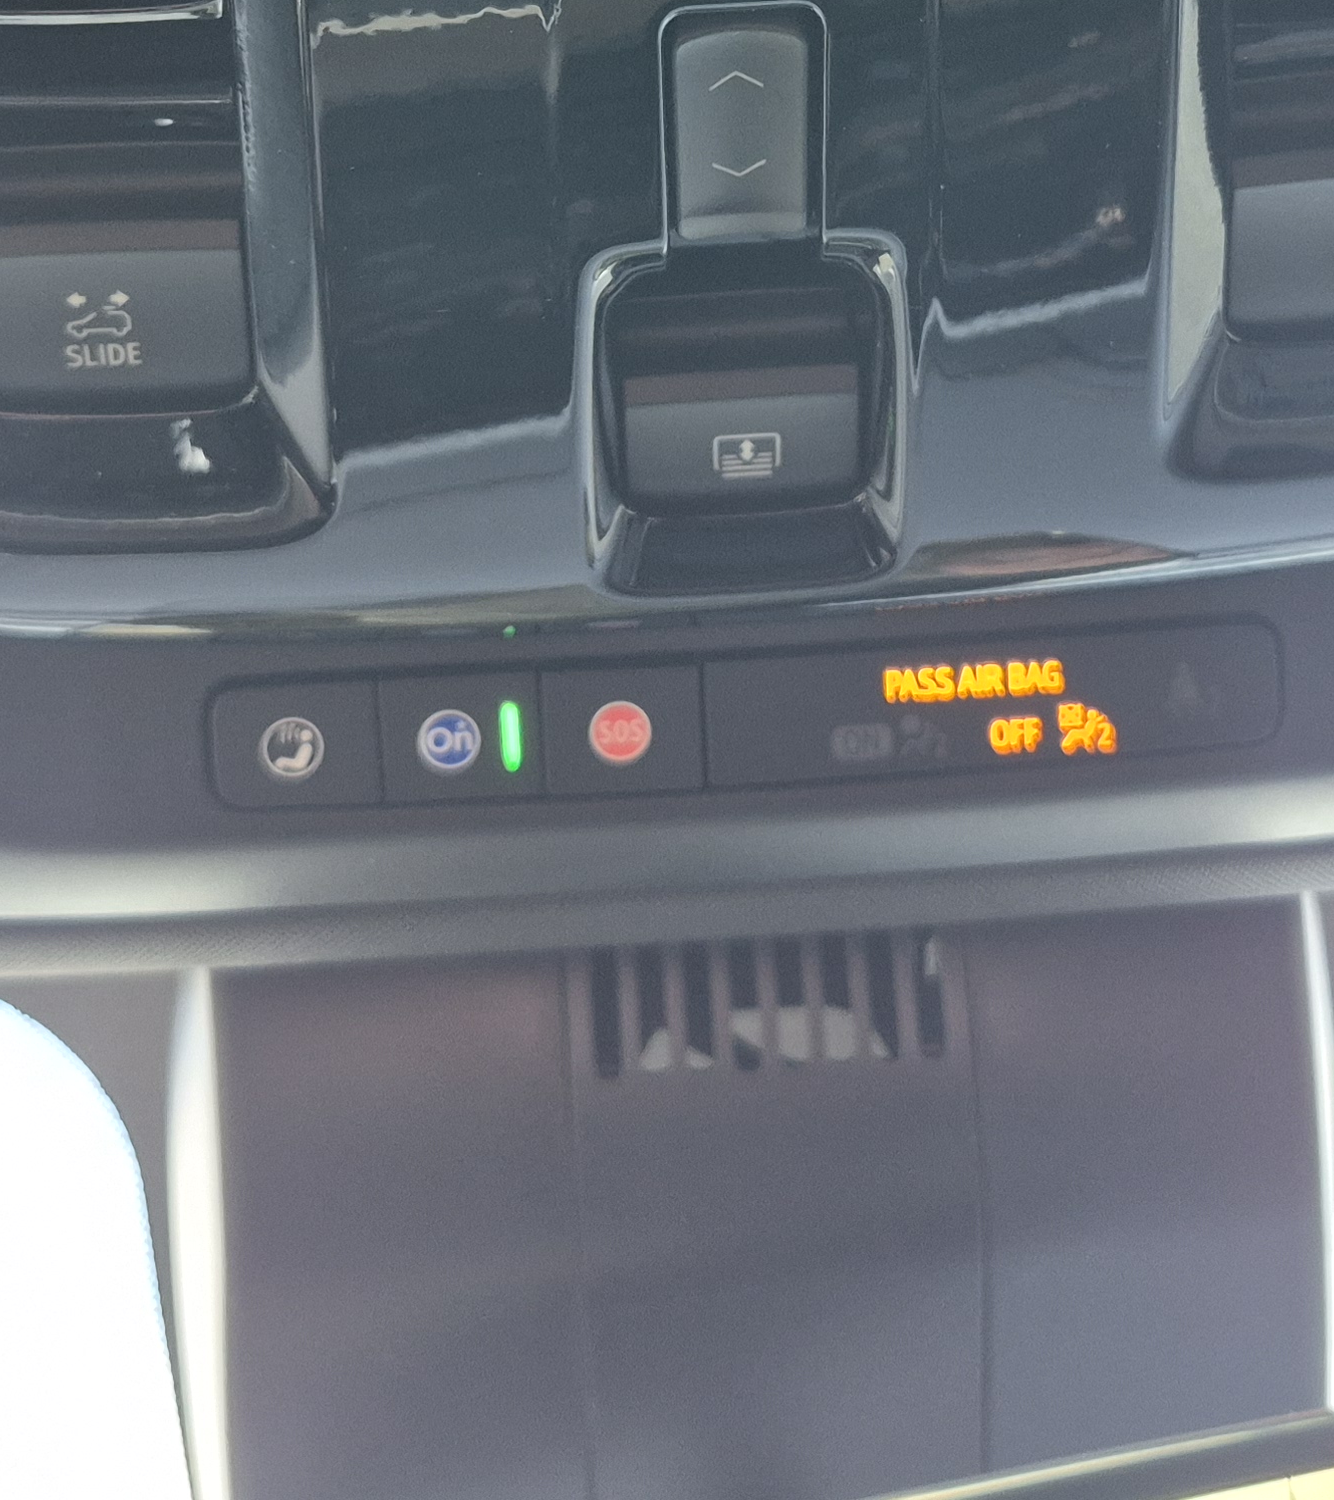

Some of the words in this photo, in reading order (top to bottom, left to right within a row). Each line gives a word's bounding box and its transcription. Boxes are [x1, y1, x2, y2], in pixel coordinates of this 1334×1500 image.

[66, 342, 142, 368] SLIDE
[883, 666, 955, 703] PASS
[957, 663, 1005, 698] AIR
[1007, 658, 1065, 695] BAG
[598, 717, 645, 743] SOS
[988, 717, 1042, 754] OFF
